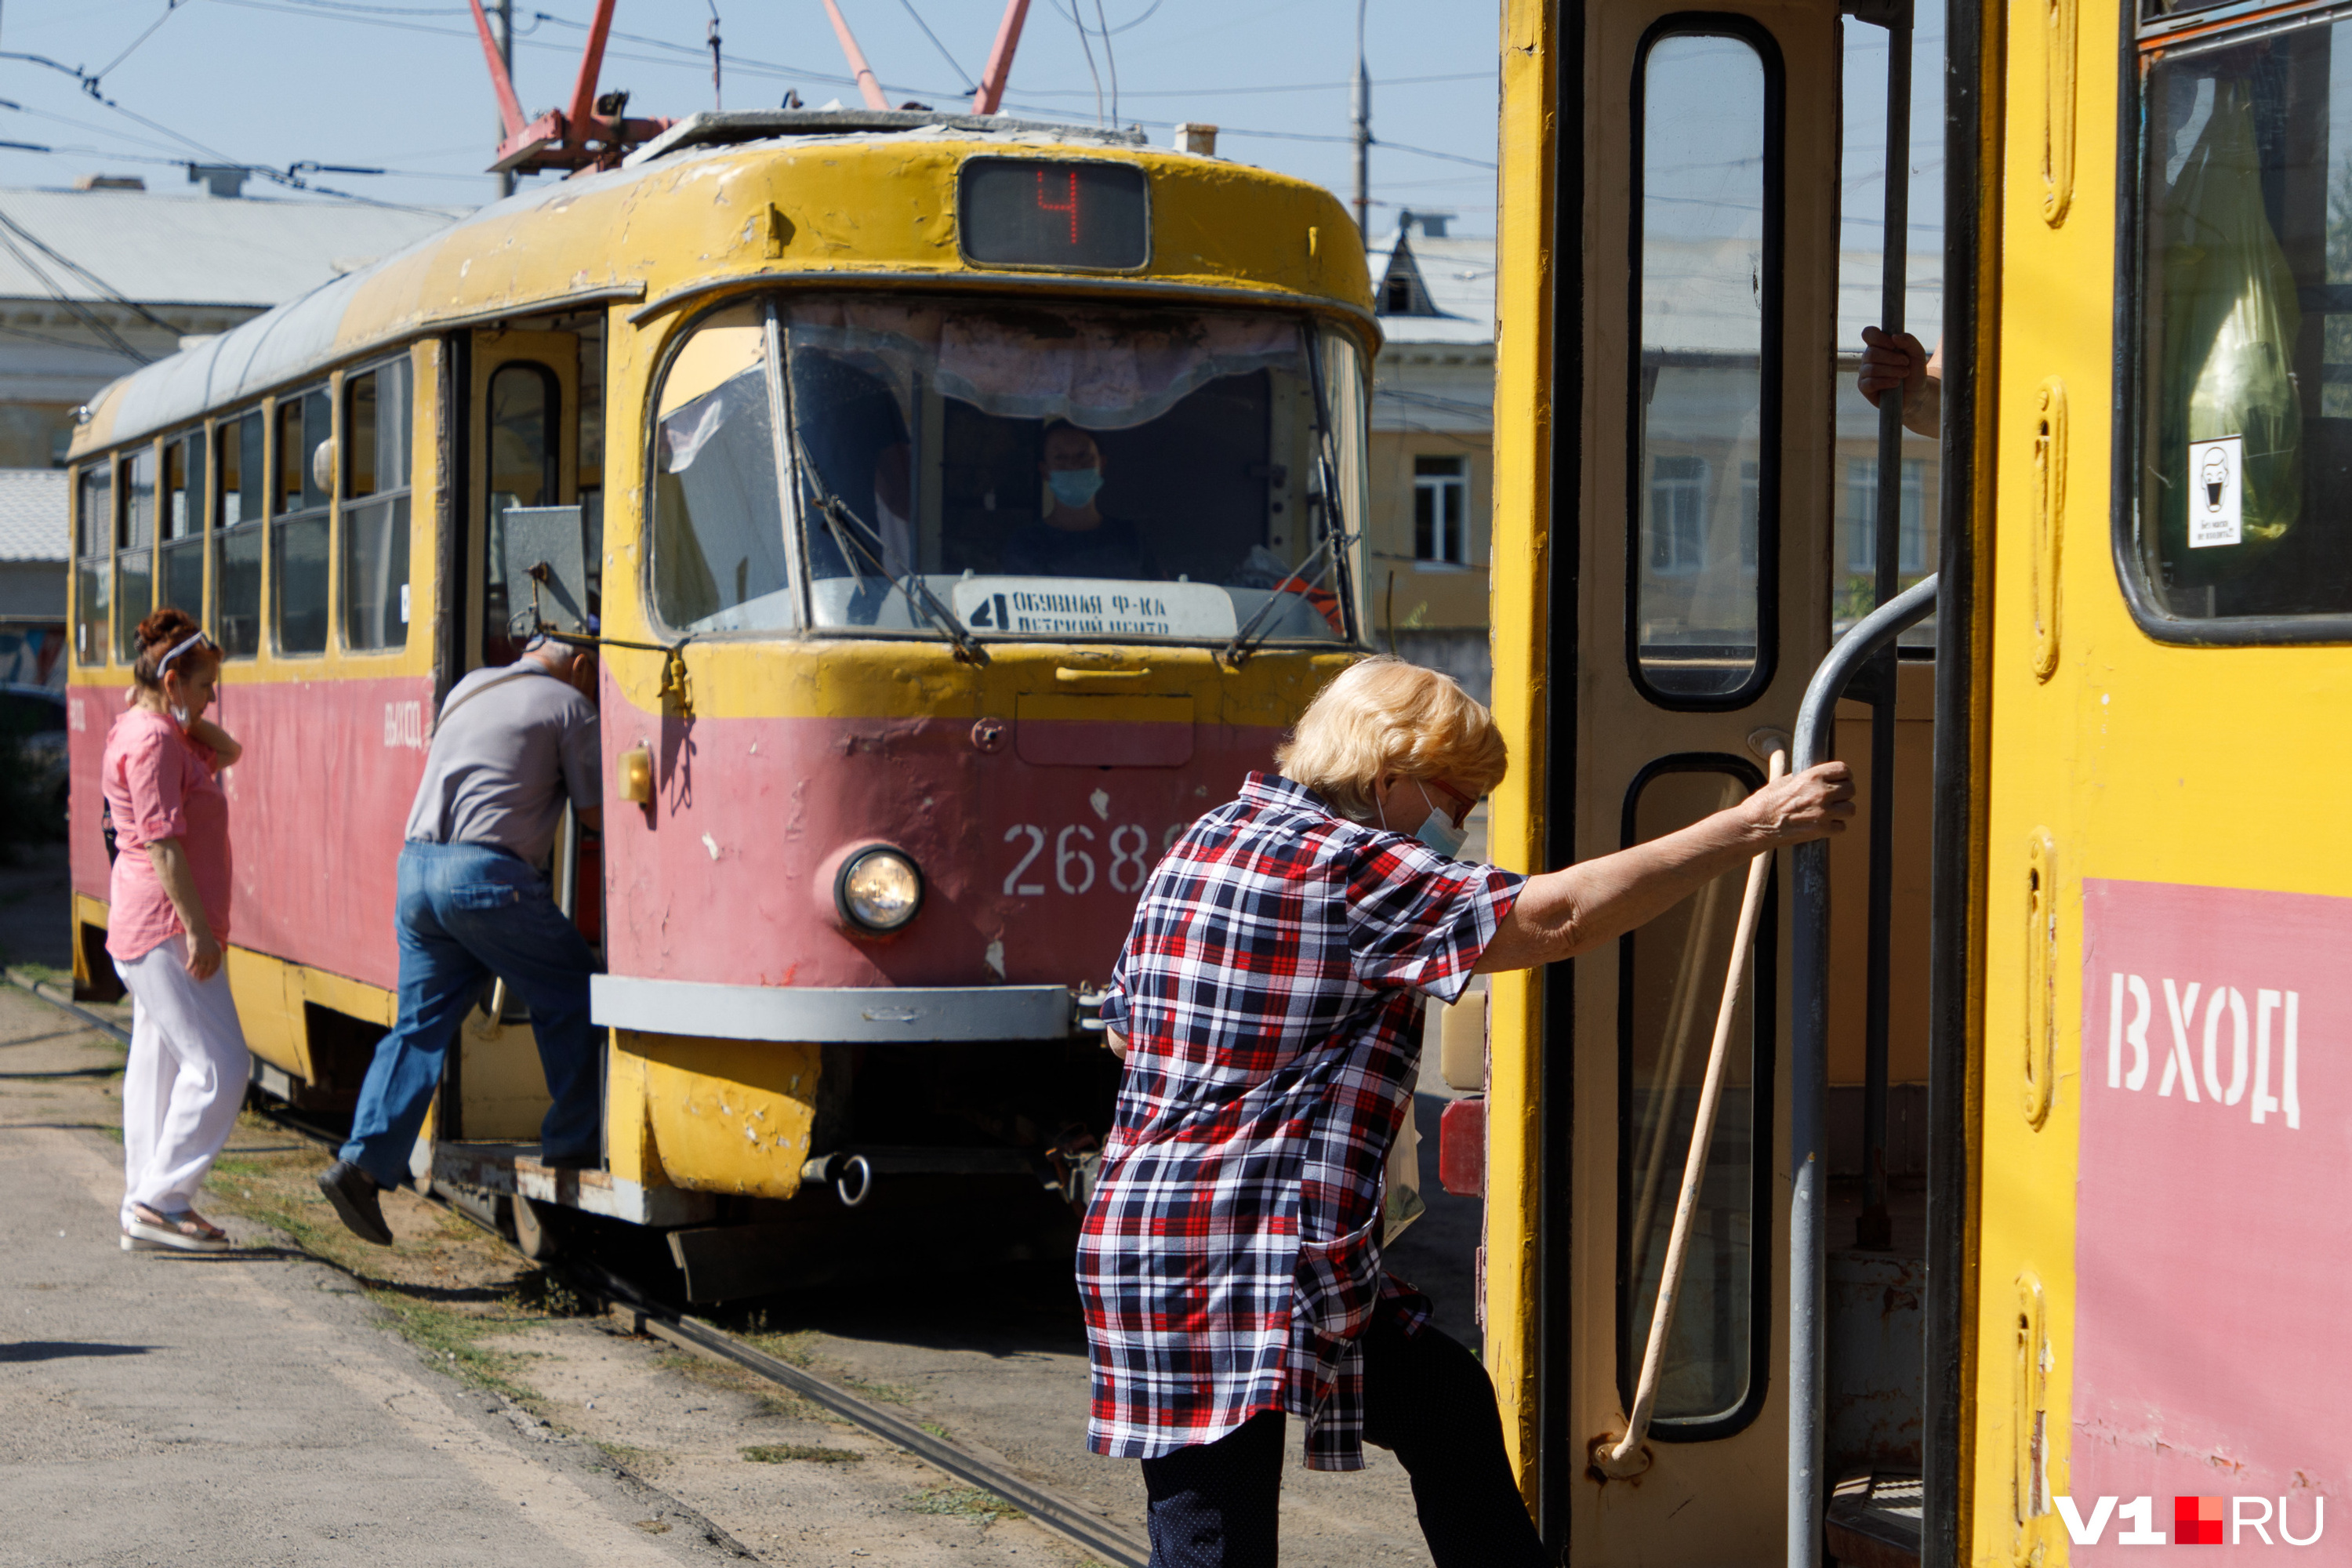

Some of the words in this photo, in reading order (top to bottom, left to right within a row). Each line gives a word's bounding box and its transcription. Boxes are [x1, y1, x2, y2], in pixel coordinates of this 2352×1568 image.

[1037, 170, 1077, 244] 4
[970, 593, 1010, 630] 4
[1013, 591, 1103, 614] ОБУВНАЯ
[1112, 594, 1167, 616] Ф-КА
[1003, 823, 1191, 895] 268
[2107, 972, 2301, 1130] ВХОД
